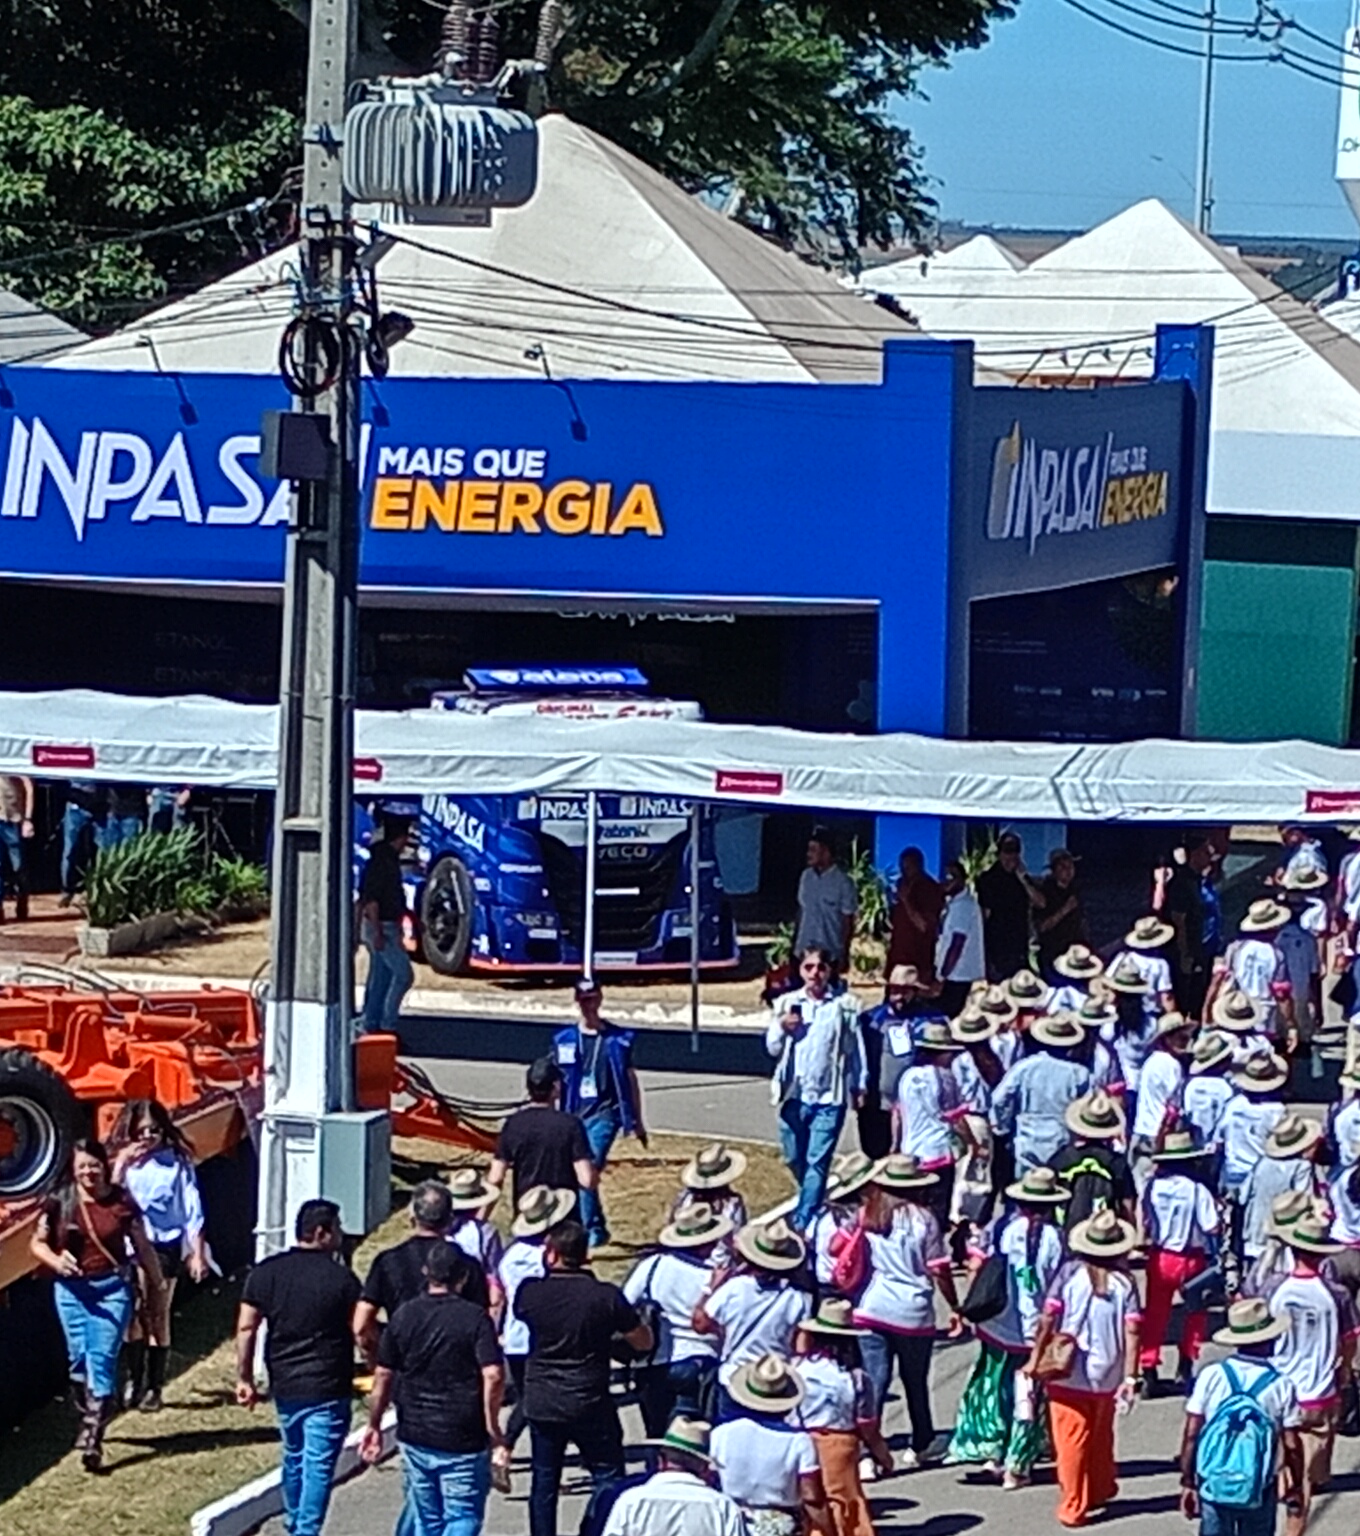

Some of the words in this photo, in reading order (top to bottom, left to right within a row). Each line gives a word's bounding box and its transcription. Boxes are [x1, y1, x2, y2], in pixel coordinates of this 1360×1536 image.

[1, 416, 297, 542] INPAS
[377, 446, 467, 475] MAIS
[474, 448, 546, 479] QUE
[368, 479, 664, 537] ENERGIA
[1013, 436, 1101, 556] INPASA
[1102, 471, 1169, 527] ENERGIA
[638, 796, 694, 818] INPAS
